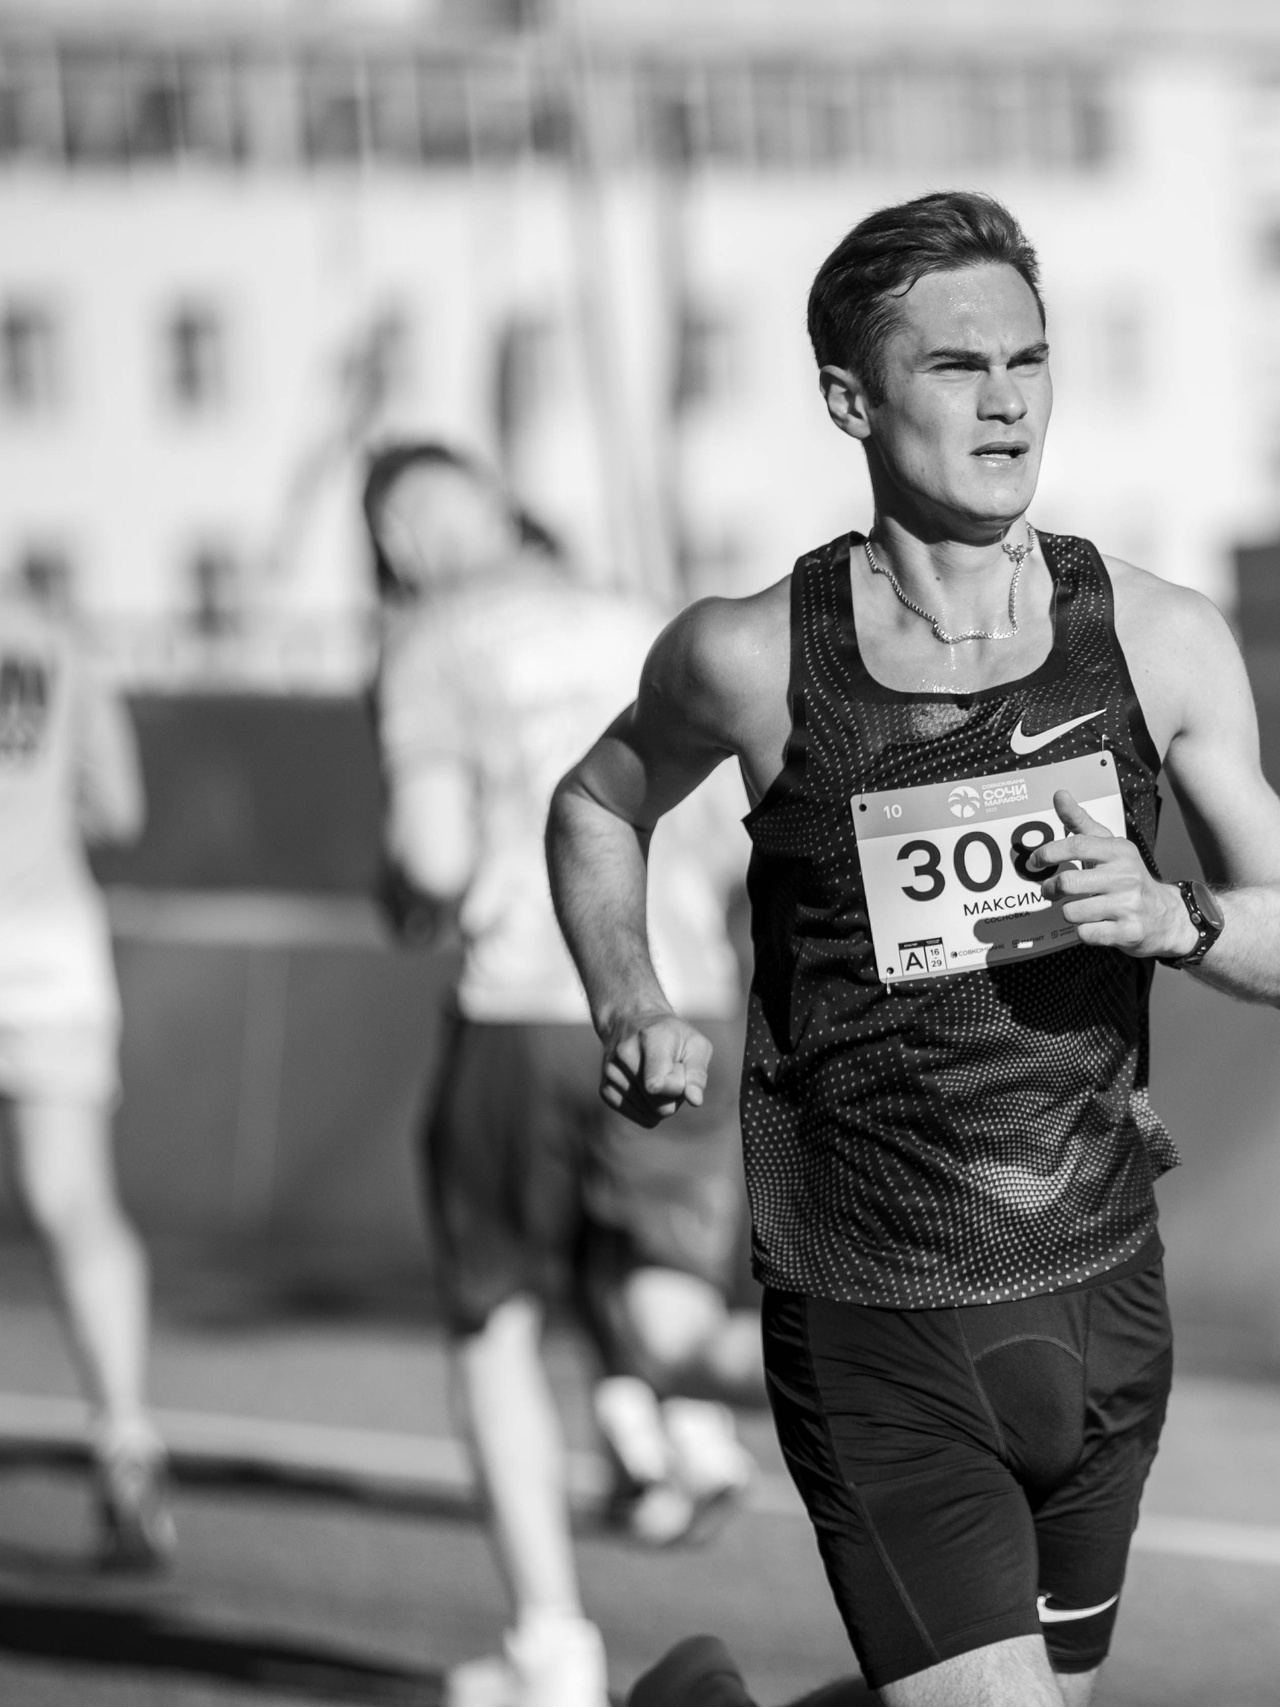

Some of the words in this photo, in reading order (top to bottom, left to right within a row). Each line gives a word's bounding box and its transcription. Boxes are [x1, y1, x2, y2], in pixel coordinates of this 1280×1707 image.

[982, 783, 1028, 801] СОЧИ
[984, 793, 1029, 808] МАРАФОН
[883, 804, 902, 819] 10
[897, 821, 1097, 902] 308
